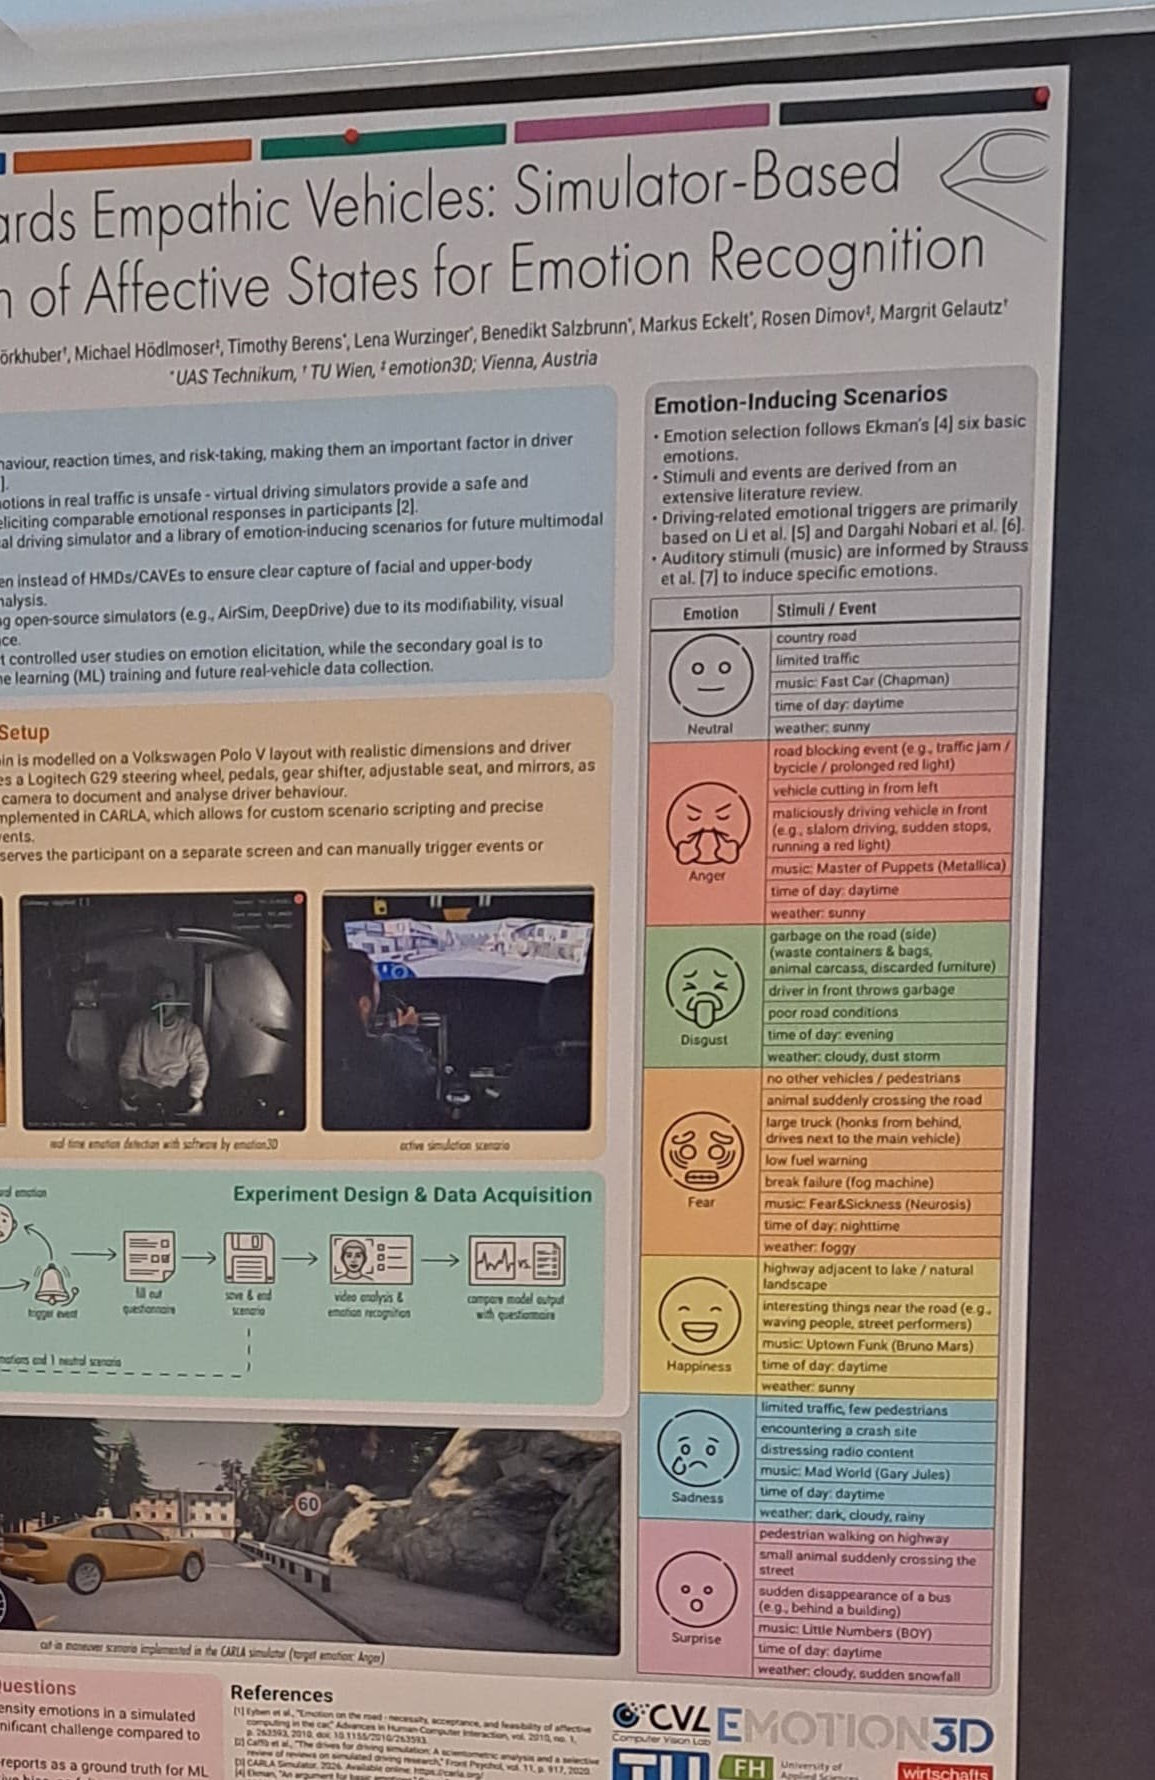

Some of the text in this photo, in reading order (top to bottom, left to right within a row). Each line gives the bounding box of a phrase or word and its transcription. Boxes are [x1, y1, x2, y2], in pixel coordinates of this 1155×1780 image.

[94, 178, 289, 252] Empathic
[305, 166, 494, 228] Vehicles:
[514, 135, 899, 215] Simulator-Based
[30, 262, 71, 318] of
[84, 258, 269, 315] Affective
[287, 255, 418, 306] States
[434, 241, 493, 297] for
[511, 241, 689, 292] Emotion
[711, 225, 983, 291] Recognition
[74, 341, 131, 361] Michael
[226, 335, 288, 356] Timothy
[354, 332, 390, 349] Lena
[481, 321, 547, 342] Benedikt
[639, 314, 697, 333] Markus
[761, 309, 811, 327] Rosen
[879, 302, 937, 324] Margrit
[212, 348, 598, 384] Technikum, TU Wien, Vienna, Austria
[654, 383, 947, 415] Emotion-Inducing Scenarios
[663, 427, 727, 443] Emotion
[731, 424, 800, 441] selection
[805, 421, 861, 437] follows
[933, 416, 953, 434] [4]
[957, 416, 979, 430] six
[984, 414, 1026, 429] basic
[52, 453, 109, 468] reaction
[113, 453, 155, 466] times,
[159, 448, 186, 464] and
[189, 446, 266, 463] risk-taking,
[270, 443, 323, 461] making
[327, 442, 364, 457] them
[368, 443, 386, 455] an
[390, 437, 462, 456] important
[466, 435, 510, 450] factor
[513, 434, 527, 448] in
[530, 432, 573, 447] driver
[663, 447, 738, 464] emotions.
[683, 605, 739, 621] Emotion
[777, 601, 825, 618] Stimuli
[839, 601, 876, 615] Event
[776, 628, 857, 645] country road
[775, 671, 950, 689] music: Fast Car (Chapman)
[687, 721, 733, 735] Neutral
[772, 780, 938, 798] vehicle cutting in from left
[770, 858, 1007, 875] music: Master of Puppets (Metallica)
[688, 869, 726, 884] Anger
[768, 1005, 899, 1021] poor road conditions
[680, 1034, 728, 1048] Disgust
[765, 1153, 868, 1169] low fuel warning
[233, 1185, 592, 1207] Experiment Design & Data Acquisition
[687, 1196, 715, 1208] Fear
[666, 1359, 732, 1374] Happiness
[760, 1465, 950, 1482] music: Mad World (Gary Jules)
[298, 1496, 318, 1511] 60
[671, 1491, 724, 1504] Sadness
[671, 1631, 722, 1646] Surprise
[757, 1664, 960, 1682] weather: cloudy, sudden snowfall
[231, 1684, 333, 1703] References
[38, 1705, 100, 1718] emotions
[103, 1706, 115, 1719] in
[118, 1709, 127, 1720] a
[130, 1708, 196, 1722] simulated
[649, 1703, 711, 1733] CVL
[717, 1707, 994, 1754] EMOTION3D
[612, 1733, 712, 1746] Computer Vision Lab
[735, 1758, 767, 1779] FH
[781, 1760, 843, 1773] University of
